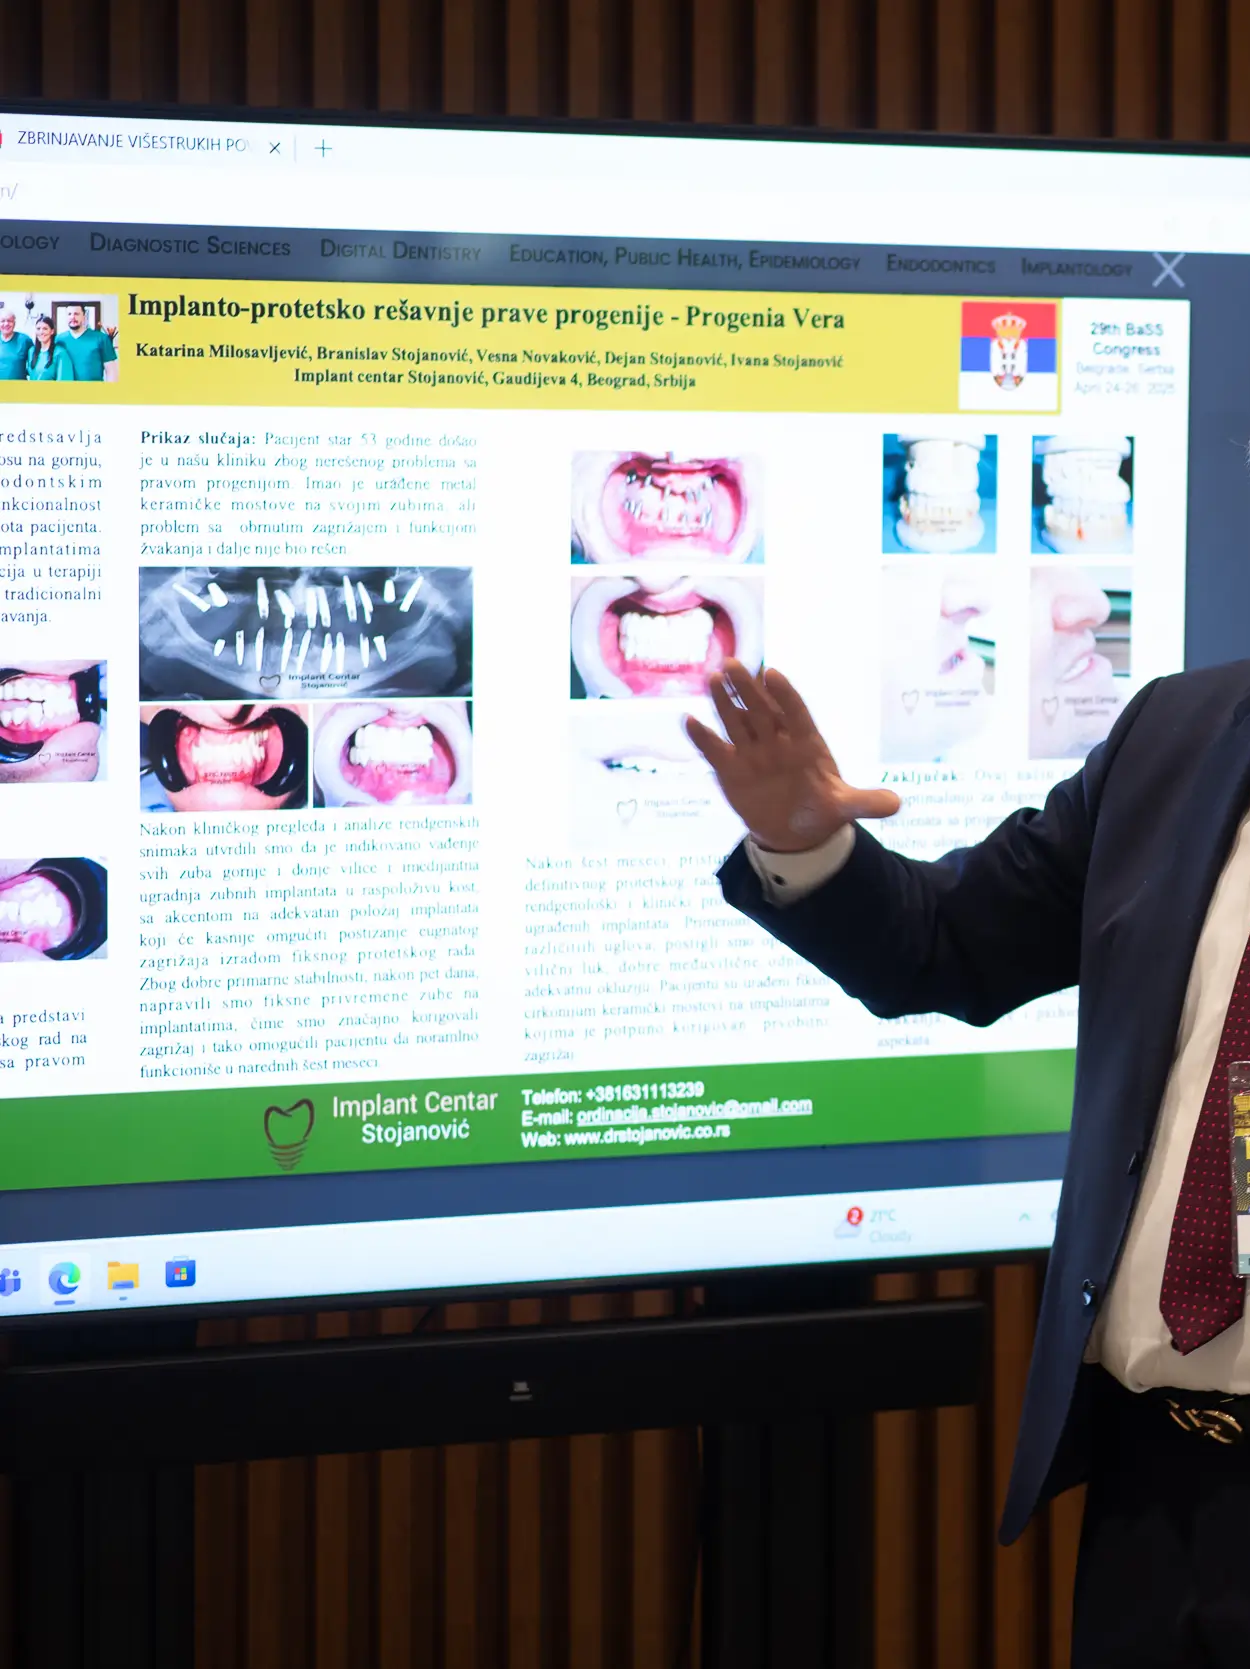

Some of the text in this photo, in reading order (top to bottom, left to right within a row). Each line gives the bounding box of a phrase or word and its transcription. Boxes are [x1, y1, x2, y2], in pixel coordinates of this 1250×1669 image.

[18, 131, 122, 148] ZBRINJAVANJE
[128, 133, 220, 151] VIŠESTRUKIH
[128, 294, 365, 324] Implanto-protetsko
[374, 299, 473, 328] rešavnje
[482, 307, 548, 329] prave
[556, 304, 663, 332] progenije
[687, 305, 785, 333] Progenia
[793, 307, 844, 329] Vera
[1126, 321, 1164, 337] BaSS
[136, 343, 843, 372] Katarina Milosavljević, Branislav Stojanović, Vesna Novaković, Dejan Stojanović, Ivana Stojanović
[1092, 341, 1161, 359] Congress
[295, 368, 696, 391] Implant centar Stojanović, Gaudijeva 4, Beograd, Srbija
[0, 430, 101, 447] redstsavlja
[142, 431, 476, 449] Prikaz slučaja: Pacijent star 53 godine došao
[141, 453, 476, 470] je u našu kliniku zbog nerešenog problema sa
[1, 474, 101, 488] odontskim
[141, 479, 195, 492] pravom
[307, 476, 340, 489] Imao
[353, 481, 363, 492] je
[442, 478, 475, 490] metal
[141, 496, 220, 510] keramičke
[232, 499, 294, 510] mostove
[306, 501, 320, 510] na
[330, 501, 380, 513] svojim
[459, 498, 475, 512] ali
[1, 521, 102, 537] ota pacijenta.
[141, 520, 198, 536] problem
[209, 524, 222, 532] sa
[240, 520, 302, 532] obrnutim
[313, 522, 386, 535] zagrižajem
[410, 521, 475, 532] funkcijom
[141, 541, 202, 558] žvakanja
[217, 541, 250, 556] dalje
[256, 545, 280, 557] nije
[286, 541, 306, 555] bio
[5, 587, 100, 600] tradicionalni
[140, 987, 478, 1015] napravili smo fiksne privremene zube na
[13, 1009, 84, 1028] predstavi
[141, 1008, 478, 1038] implantatima, čime smo značajno korigovali
[0, 1033, 28, 1050] kog
[521, 1081, 705, 1106] Telefon: +381631113239
[333, 1091, 499, 1121] Implant Centar
[521, 1109, 573, 1127] E-mail:
[361, 1119, 471, 1148] Stojanović
[521, 1124, 732, 1148] Web: www.drstojanovic.co.rs
